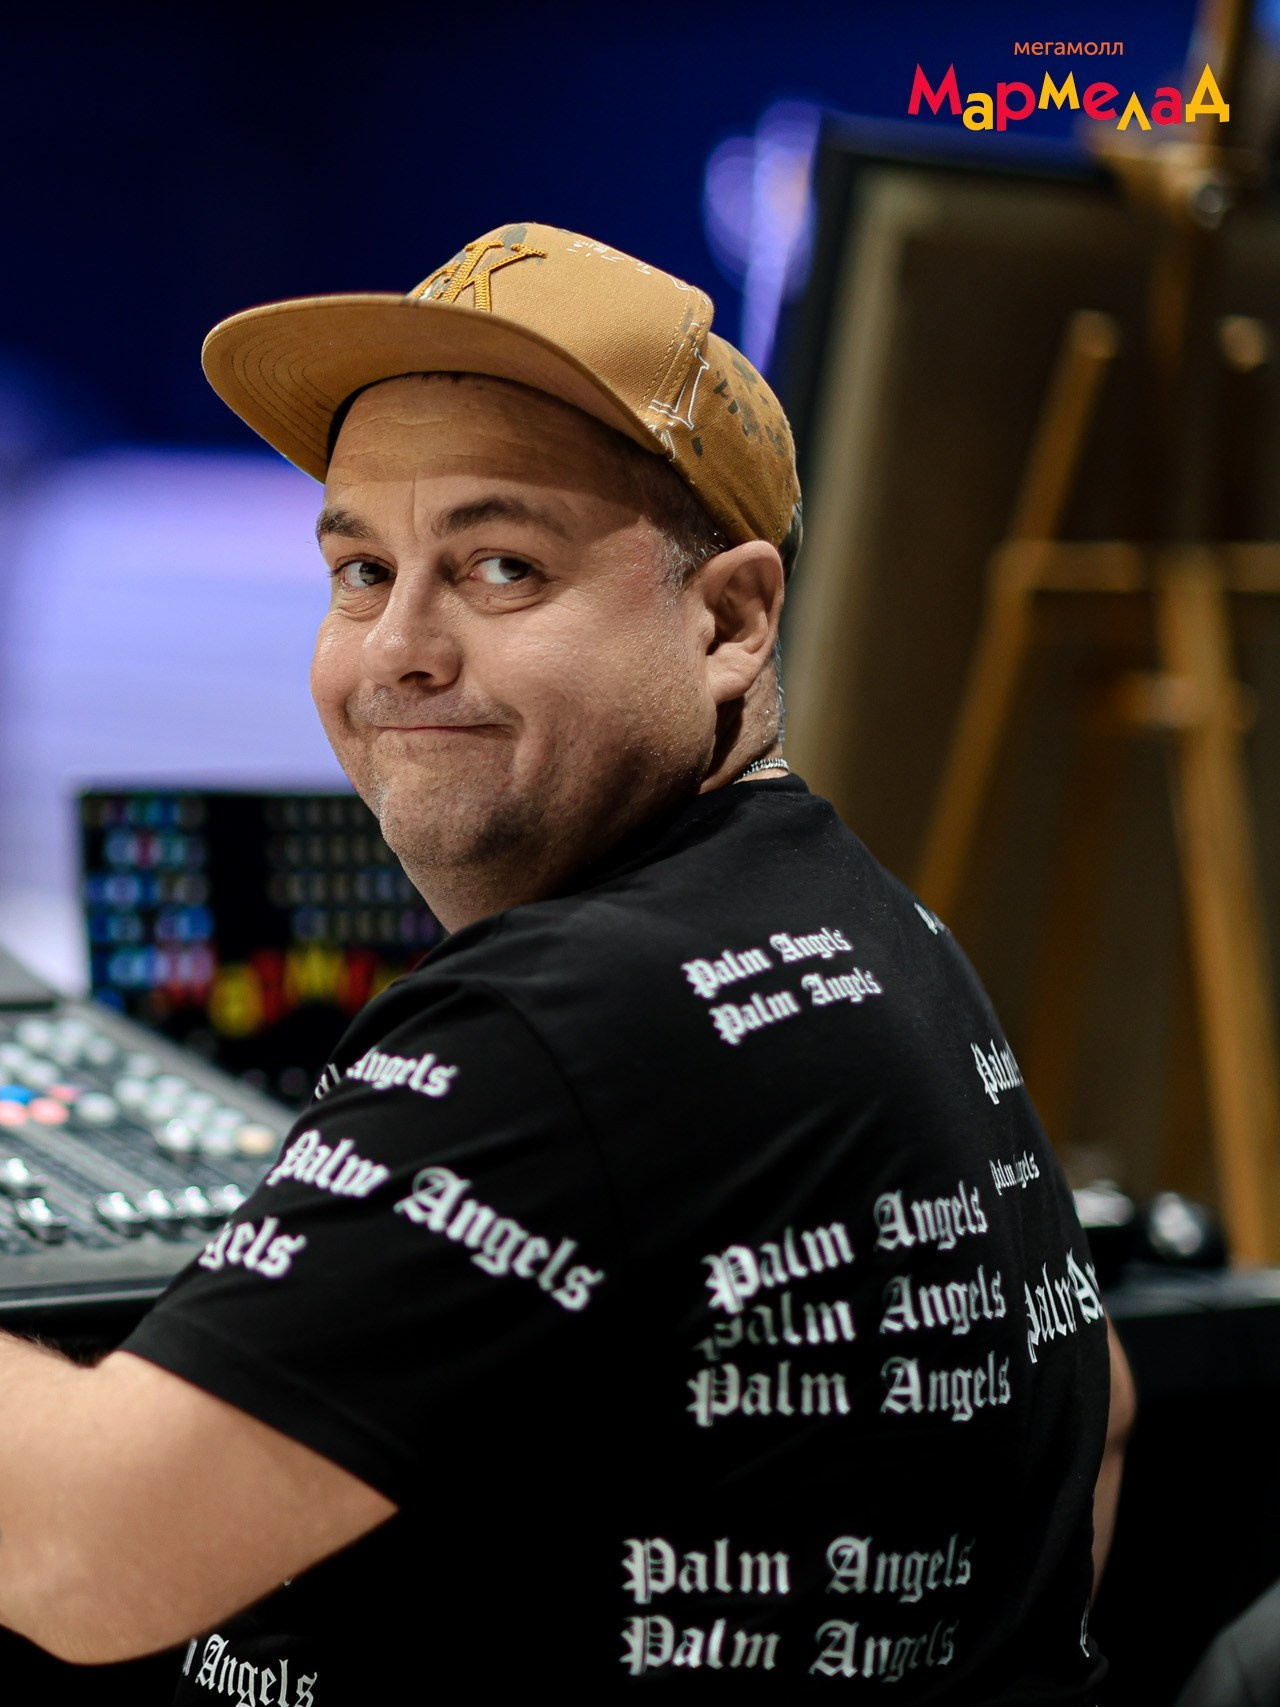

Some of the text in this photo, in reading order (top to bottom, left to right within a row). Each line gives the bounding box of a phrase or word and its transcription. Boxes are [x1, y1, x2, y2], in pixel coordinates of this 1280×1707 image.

[680, 927, 854, 999] Palm Angels
[708, 966, 884, 1045] Palm Angels
[266, 1129, 606, 1312] Palm Angels
[701, 1180, 989, 1314] Palm Angels
[878, 1264, 1006, 1335] Angels
[686, 1350, 1011, 1428] Palm Angels
[622, 1534, 976, 1604] Palm Angels
[195, 1633, 318, 1707] Angels
[619, 1615, 961, 1683] Palm Angels
